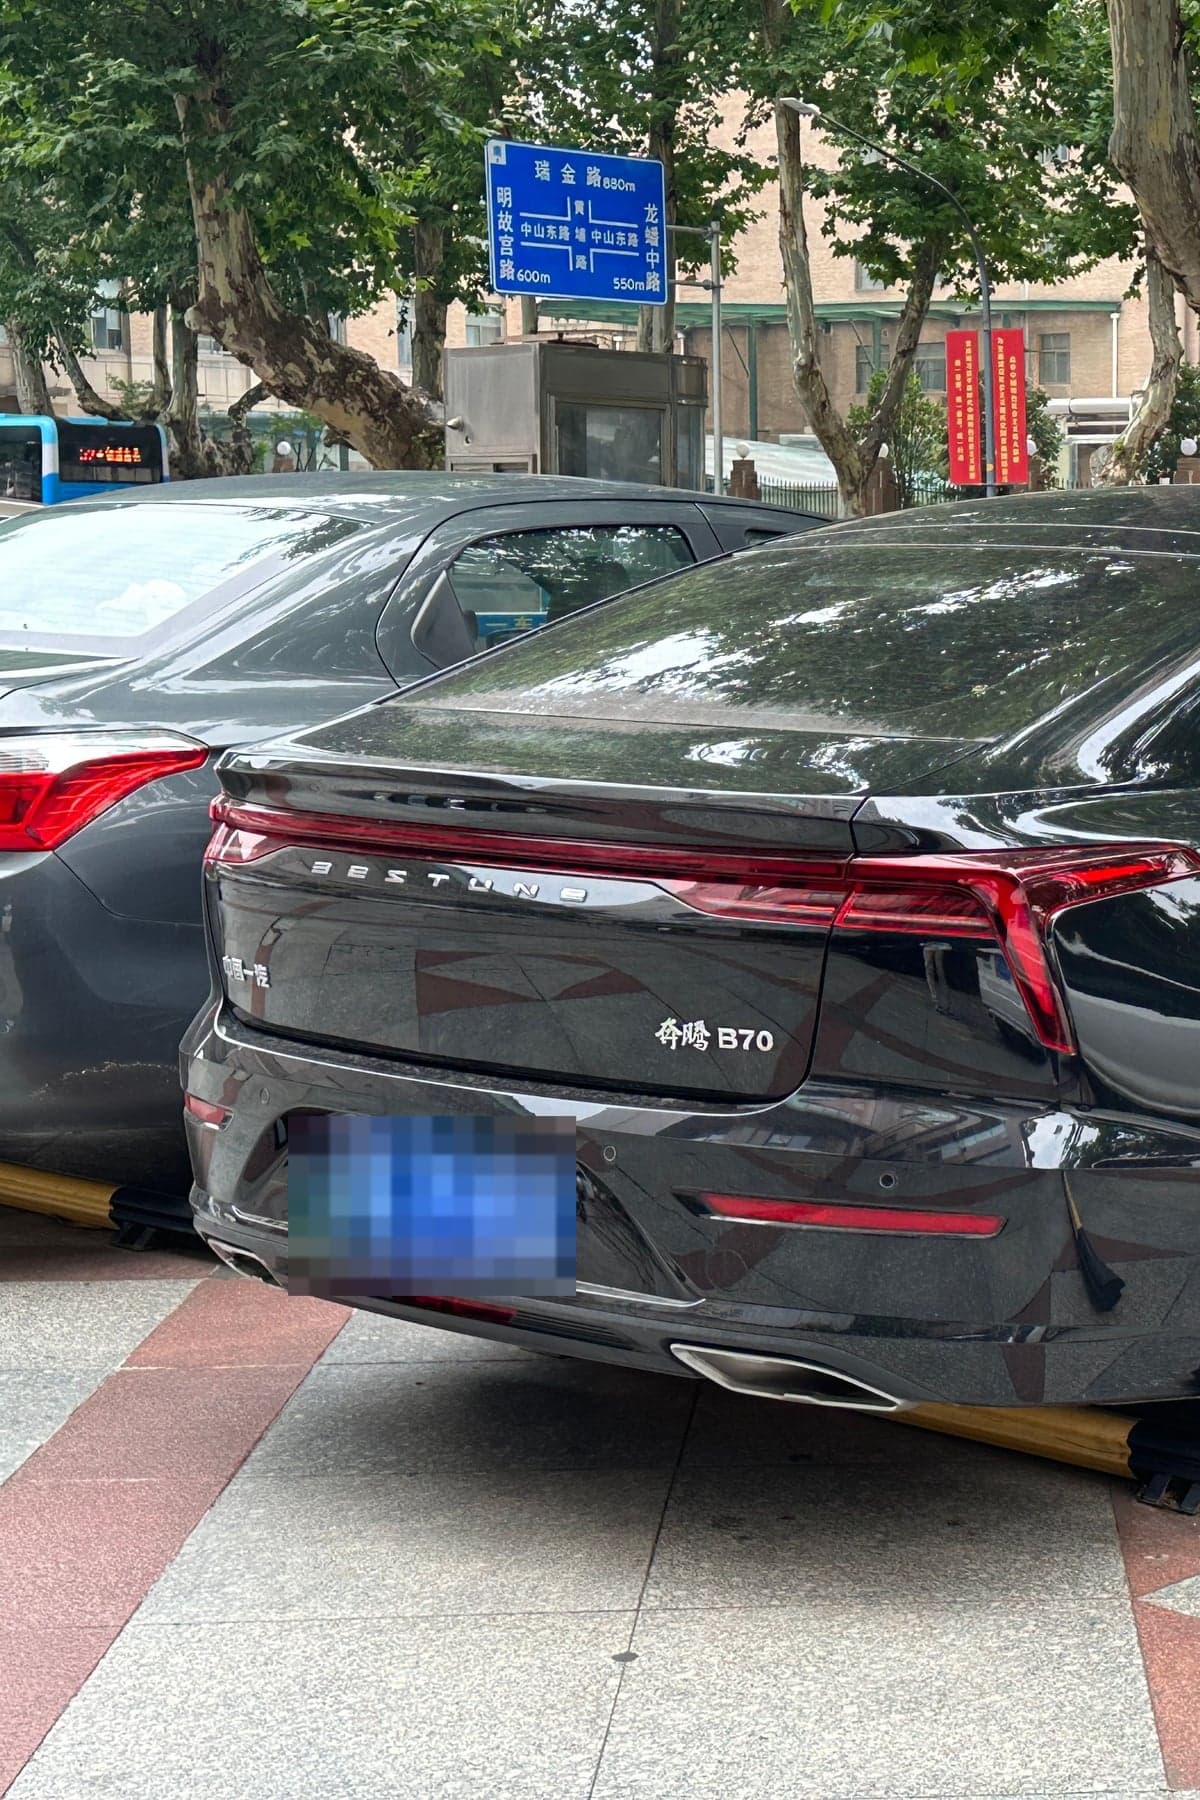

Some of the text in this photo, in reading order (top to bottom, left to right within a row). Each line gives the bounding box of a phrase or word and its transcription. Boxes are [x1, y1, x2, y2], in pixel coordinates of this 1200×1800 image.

[534, 160, 601, 188] 瑞金路
[497, 187, 514, 280] 明故宫路
[517, 269, 551, 284] 600m
[520, 222, 570, 241] 中山东路
[591, 229, 639, 247] 中山东路
[644, 203, 660, 292] 龙蟠中路
[613, 278, 645, 291] 550m
[311, 861, 587, 903] BESTUNE
[222, 955, 270, 988] 中国一汽
[655, 1017, 774, 1052] 奔腾 B70
